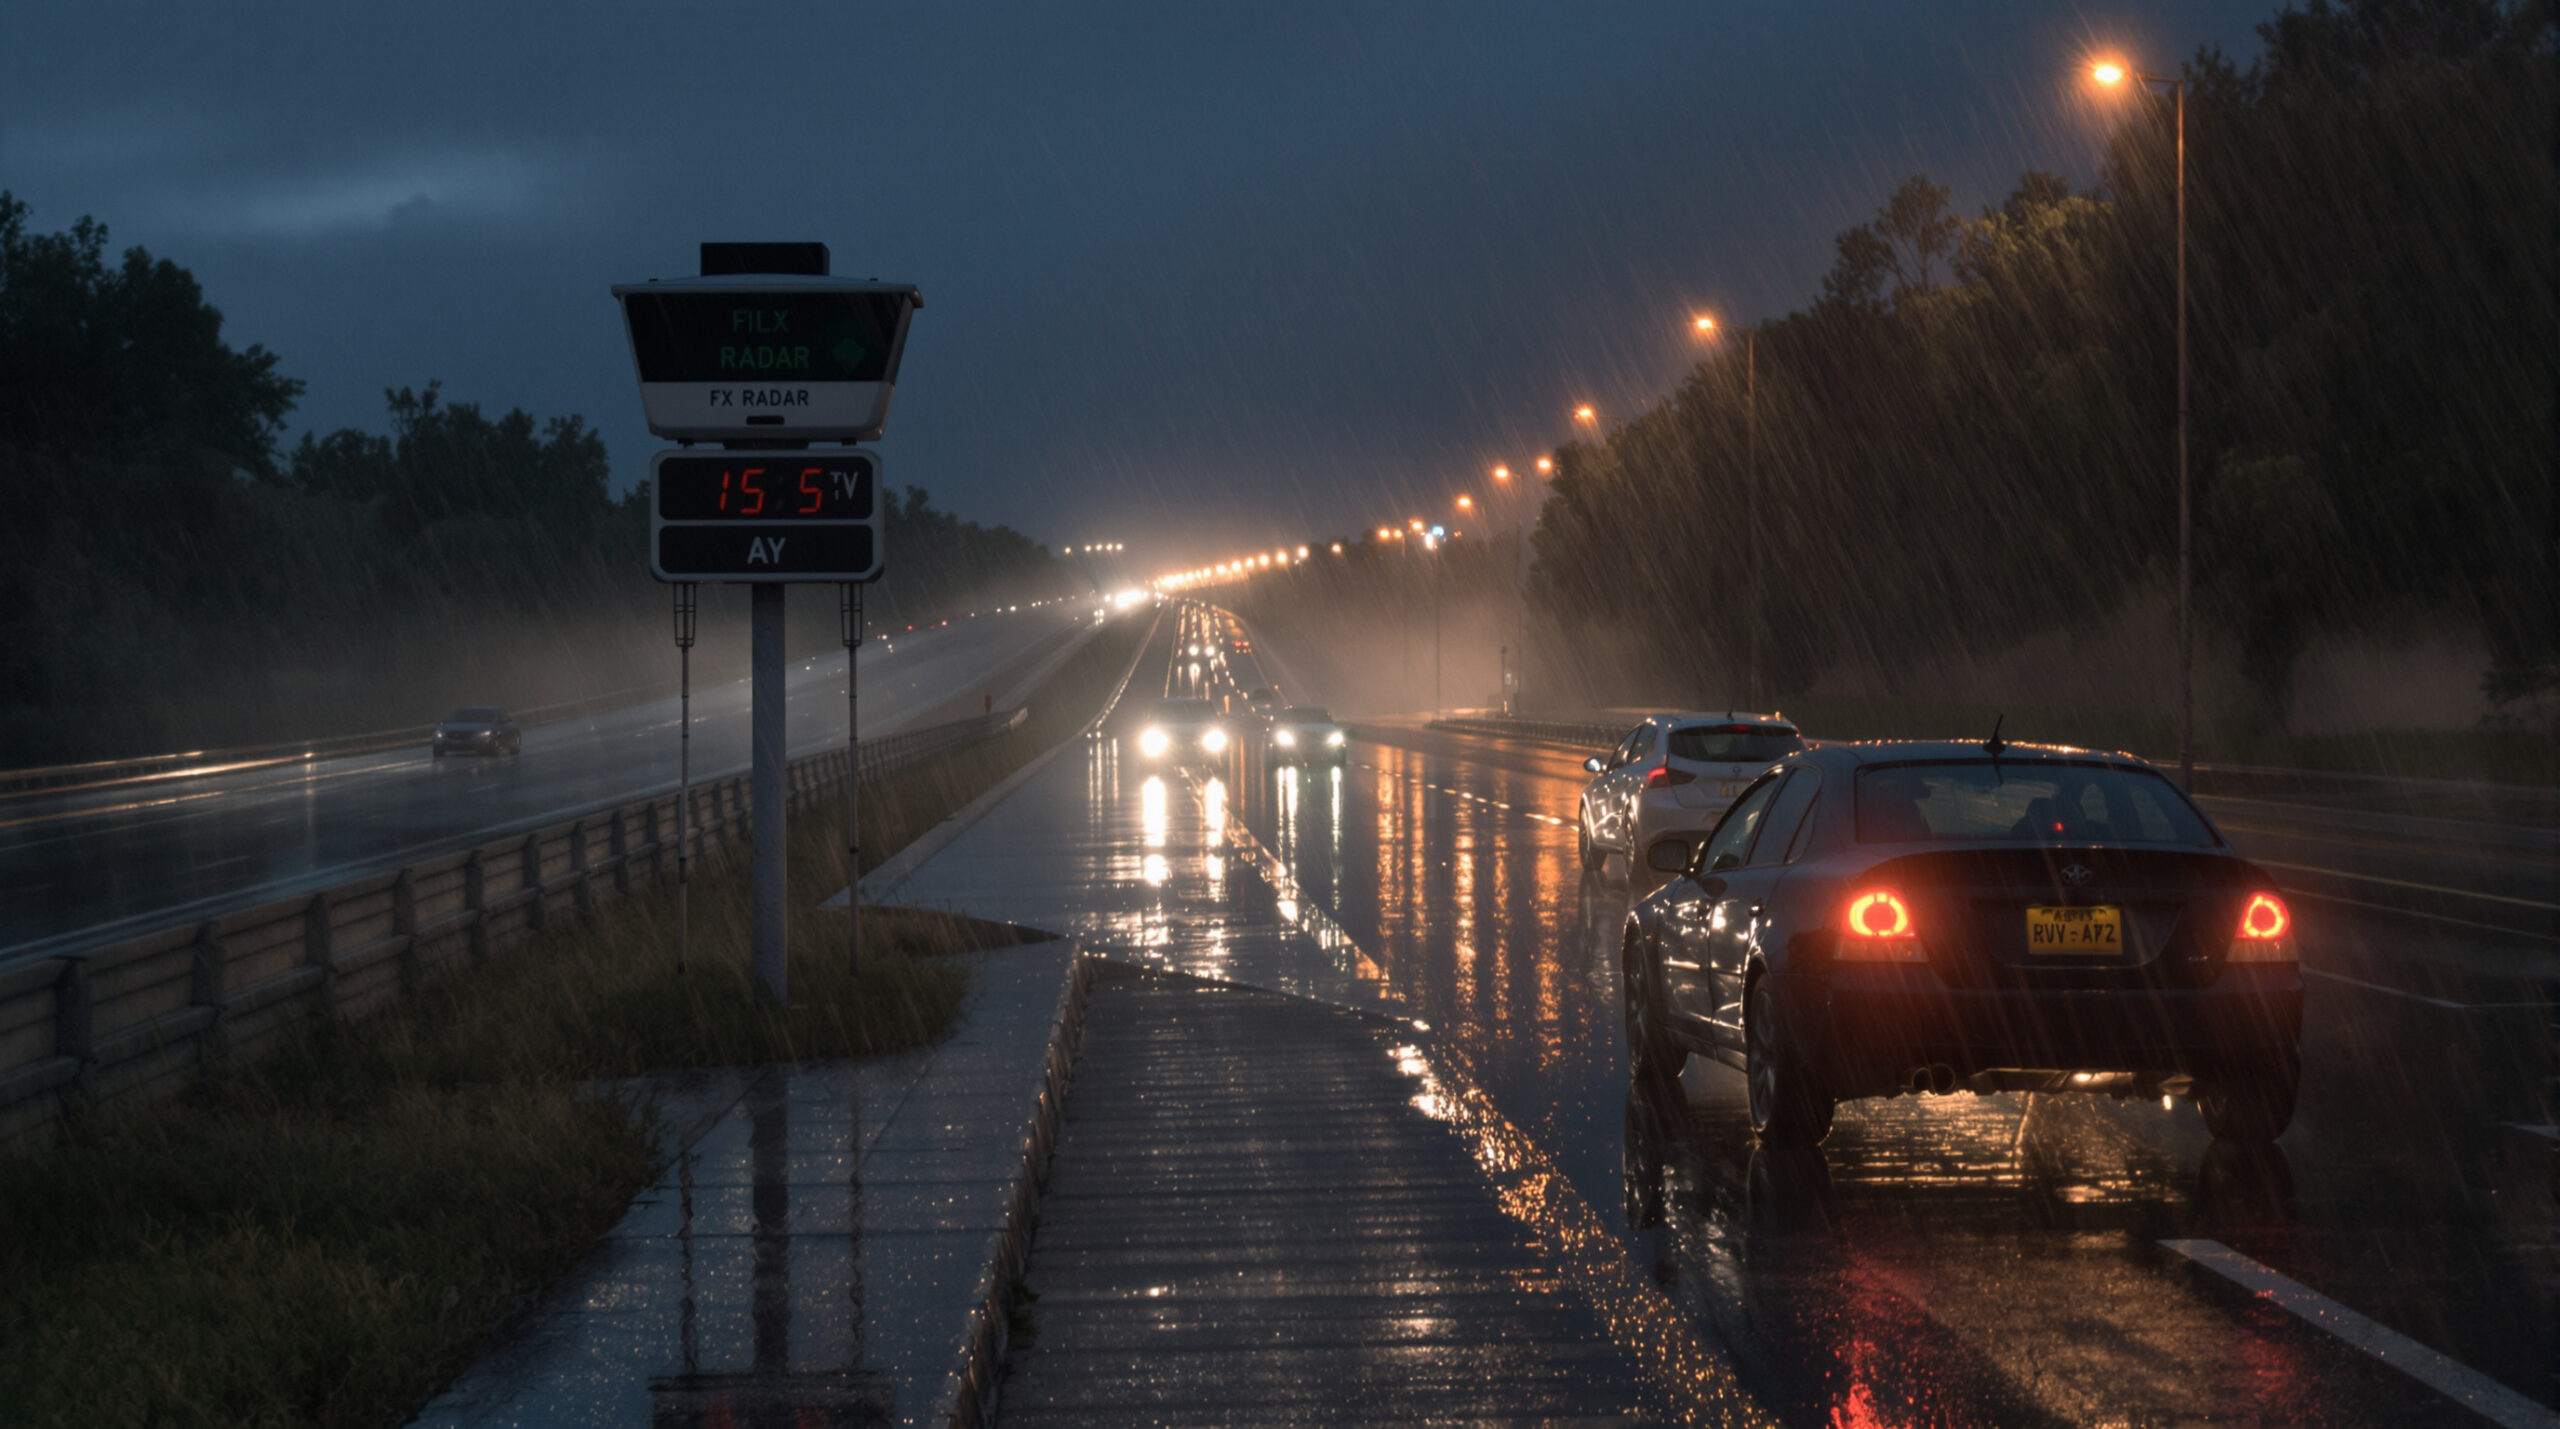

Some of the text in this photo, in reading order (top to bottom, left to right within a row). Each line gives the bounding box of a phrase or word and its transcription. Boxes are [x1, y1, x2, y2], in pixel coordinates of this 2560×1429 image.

[733, 309, 790, 333] FILX
[720, 346, 810, 369] RADAR
[710, 390, 809, 407] FX RADAR
[747, 536, 785, 564] AY
